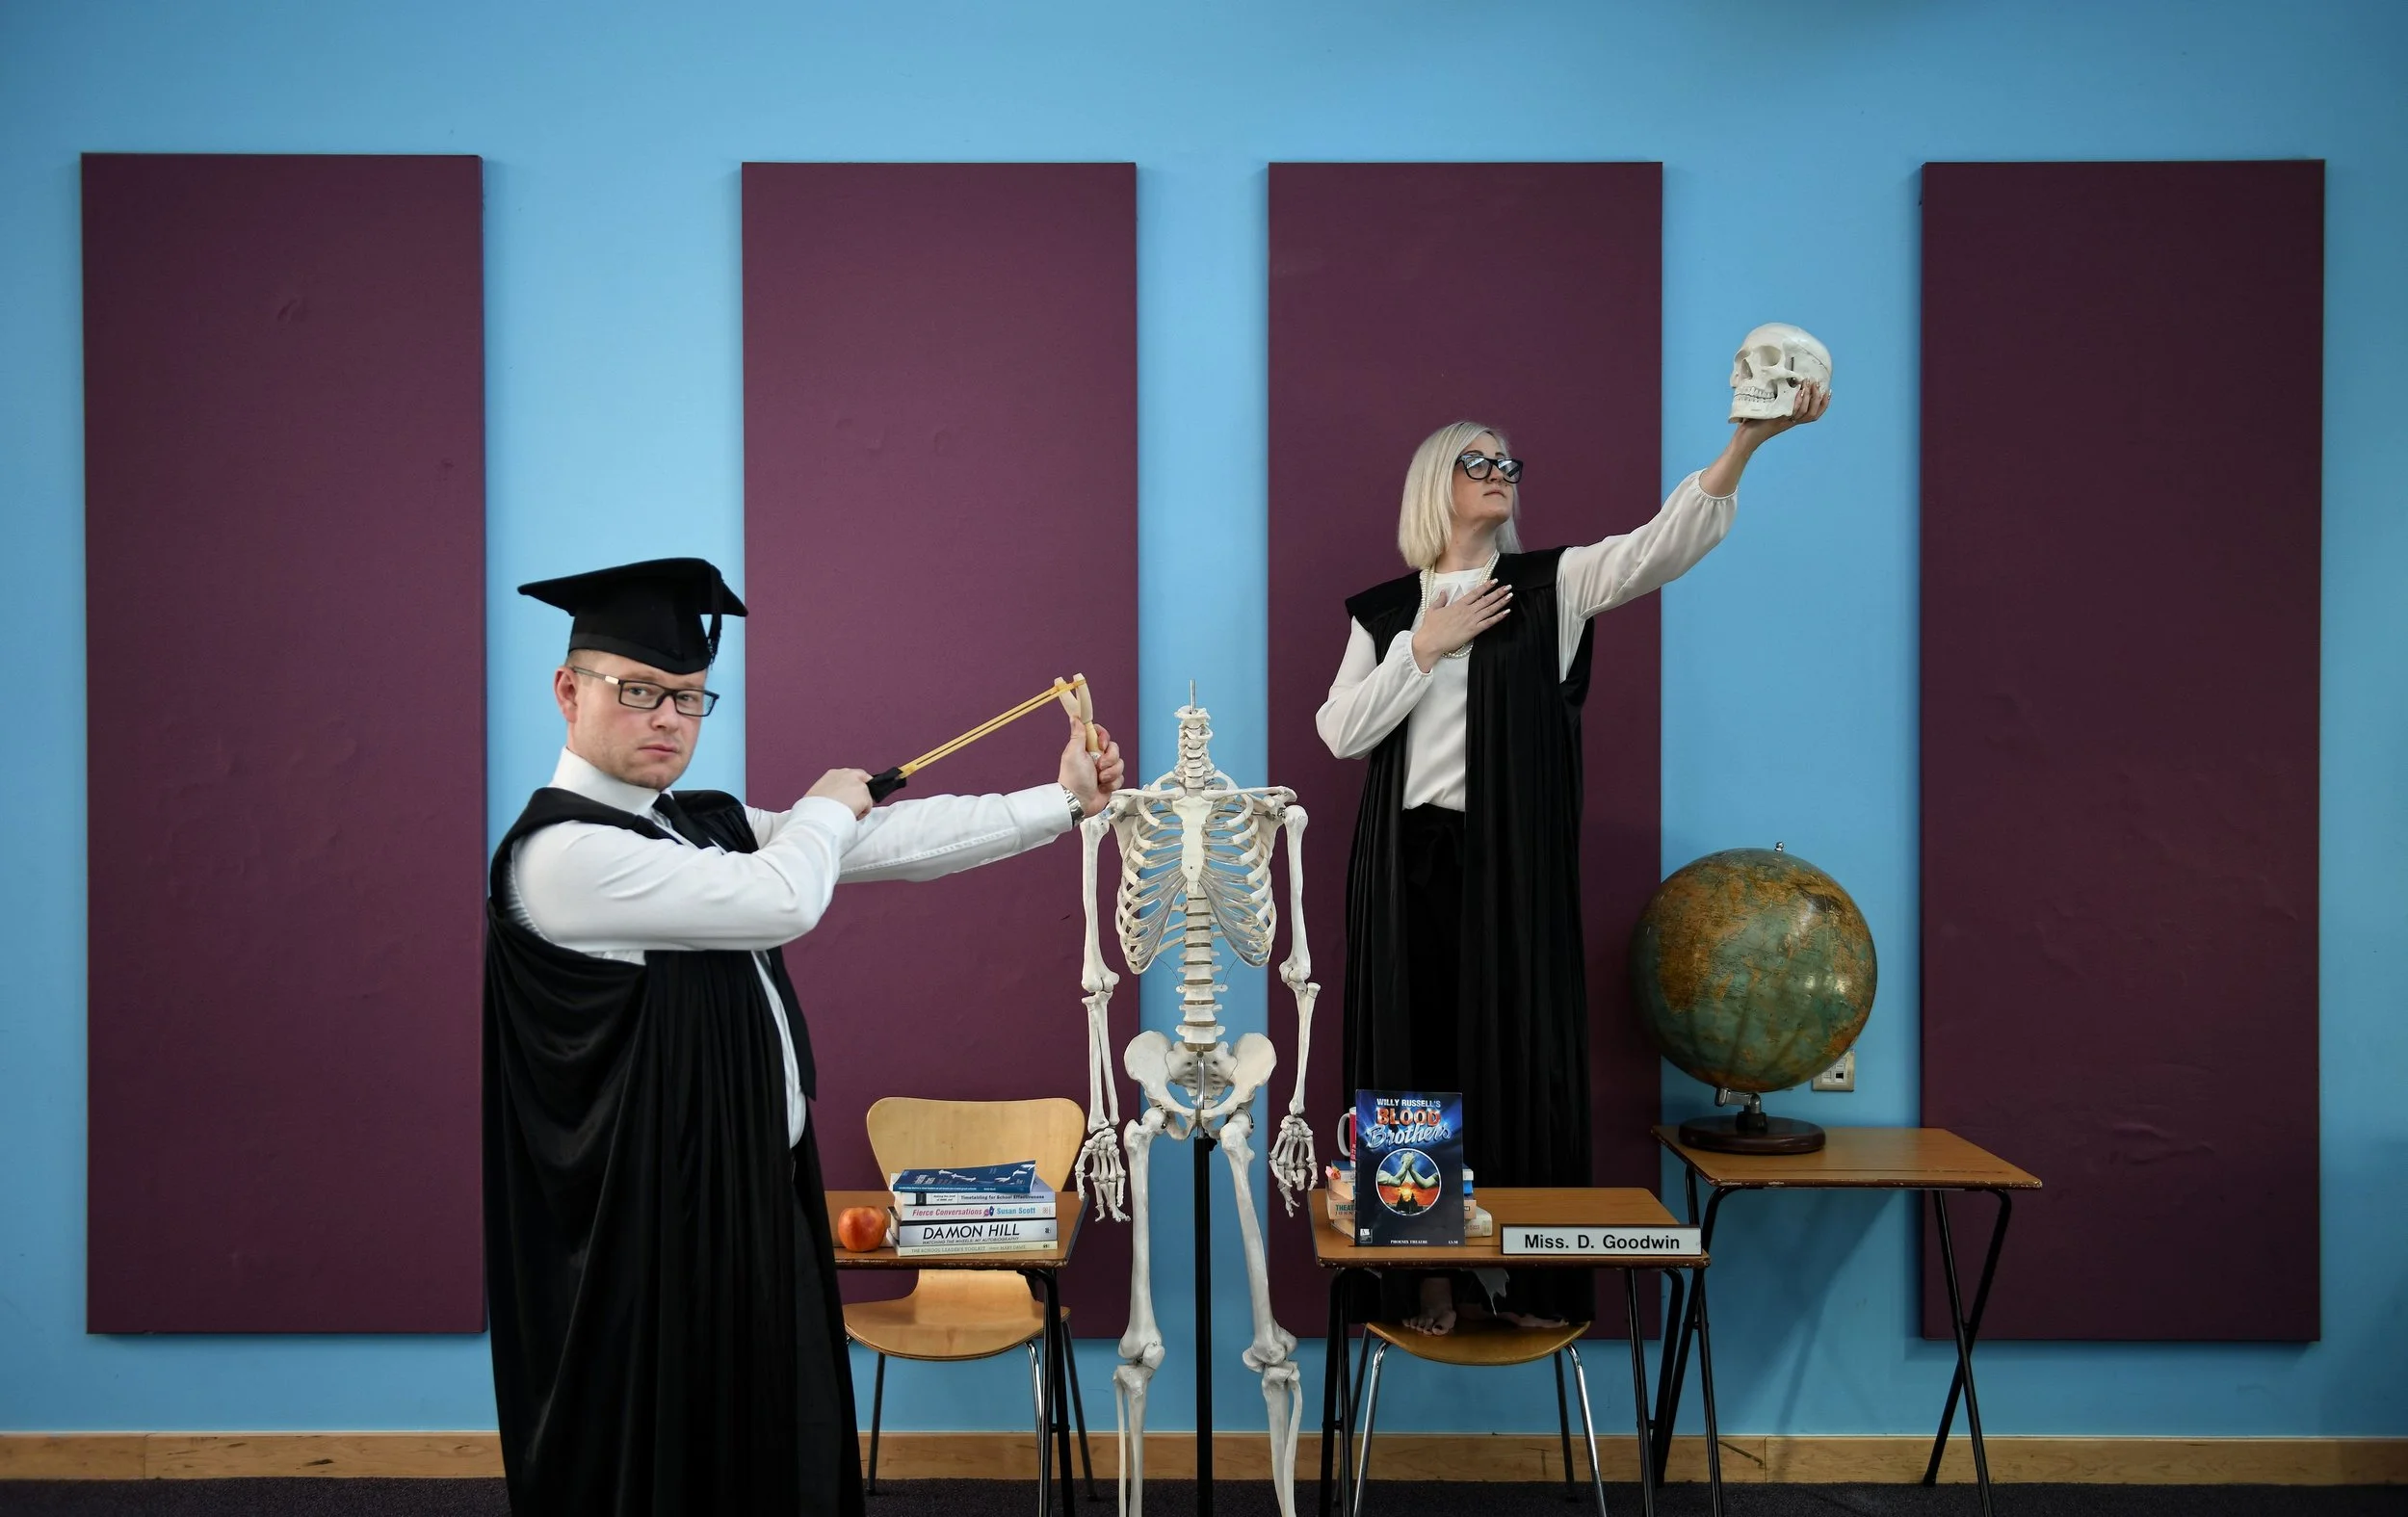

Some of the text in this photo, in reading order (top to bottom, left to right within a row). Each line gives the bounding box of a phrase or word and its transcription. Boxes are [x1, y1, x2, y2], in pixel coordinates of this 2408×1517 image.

[1376, 1098, 1441, 1108] WILLY RUSSELL'S
[1375, 1108, 1442, 1127] BLOOD
[1365, 1123, 1452, 1149] Brothers
[923, 1223, 1020, 1240] DAMON HILL
[1524, 1234, 1680, 1249] Miss. D. Goodwin
